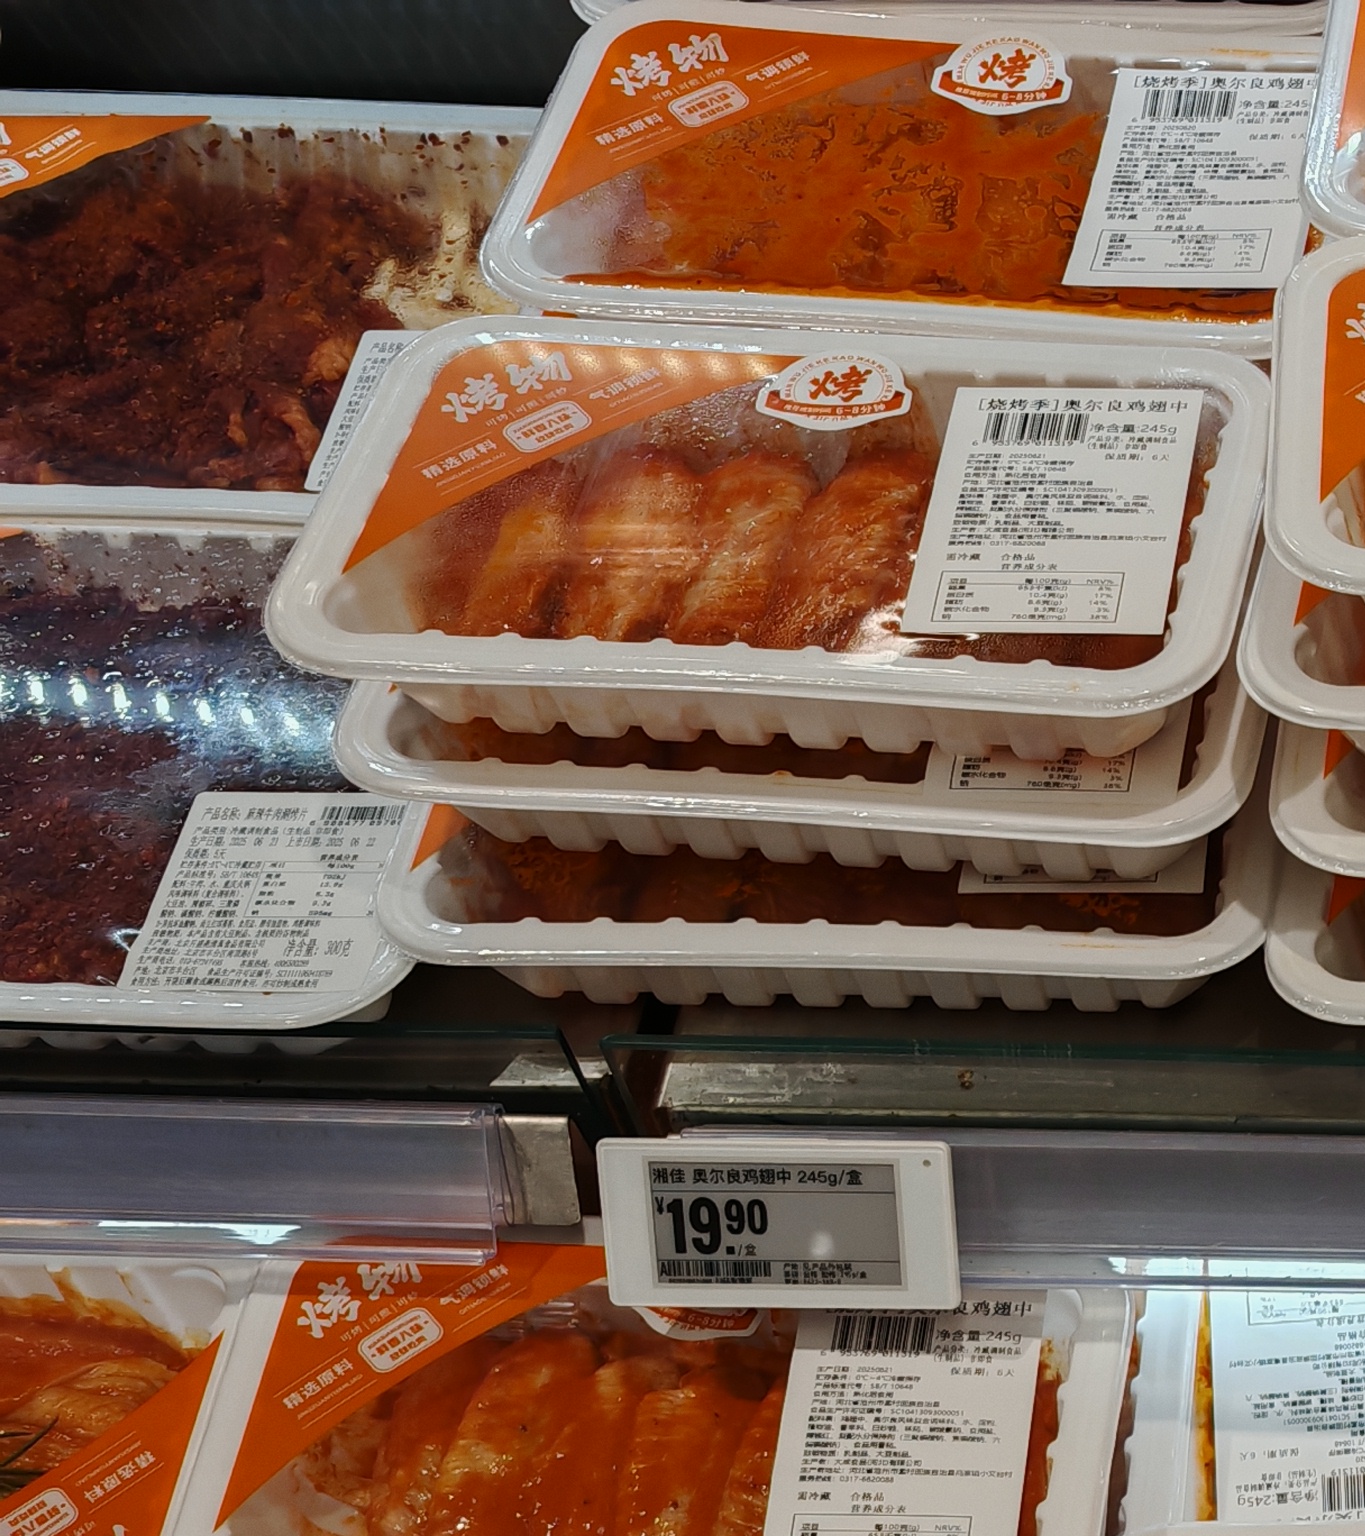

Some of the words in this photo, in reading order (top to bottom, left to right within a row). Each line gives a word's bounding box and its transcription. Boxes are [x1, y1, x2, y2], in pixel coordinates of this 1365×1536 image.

[809, 365, 873, 403] 烤
[652, 1168, 686, 1185] 湘佳
[692, 1169, 792, 1185] 奥尔良鸡翅中
[798, 1169, 863, 1187] 245g/盒
